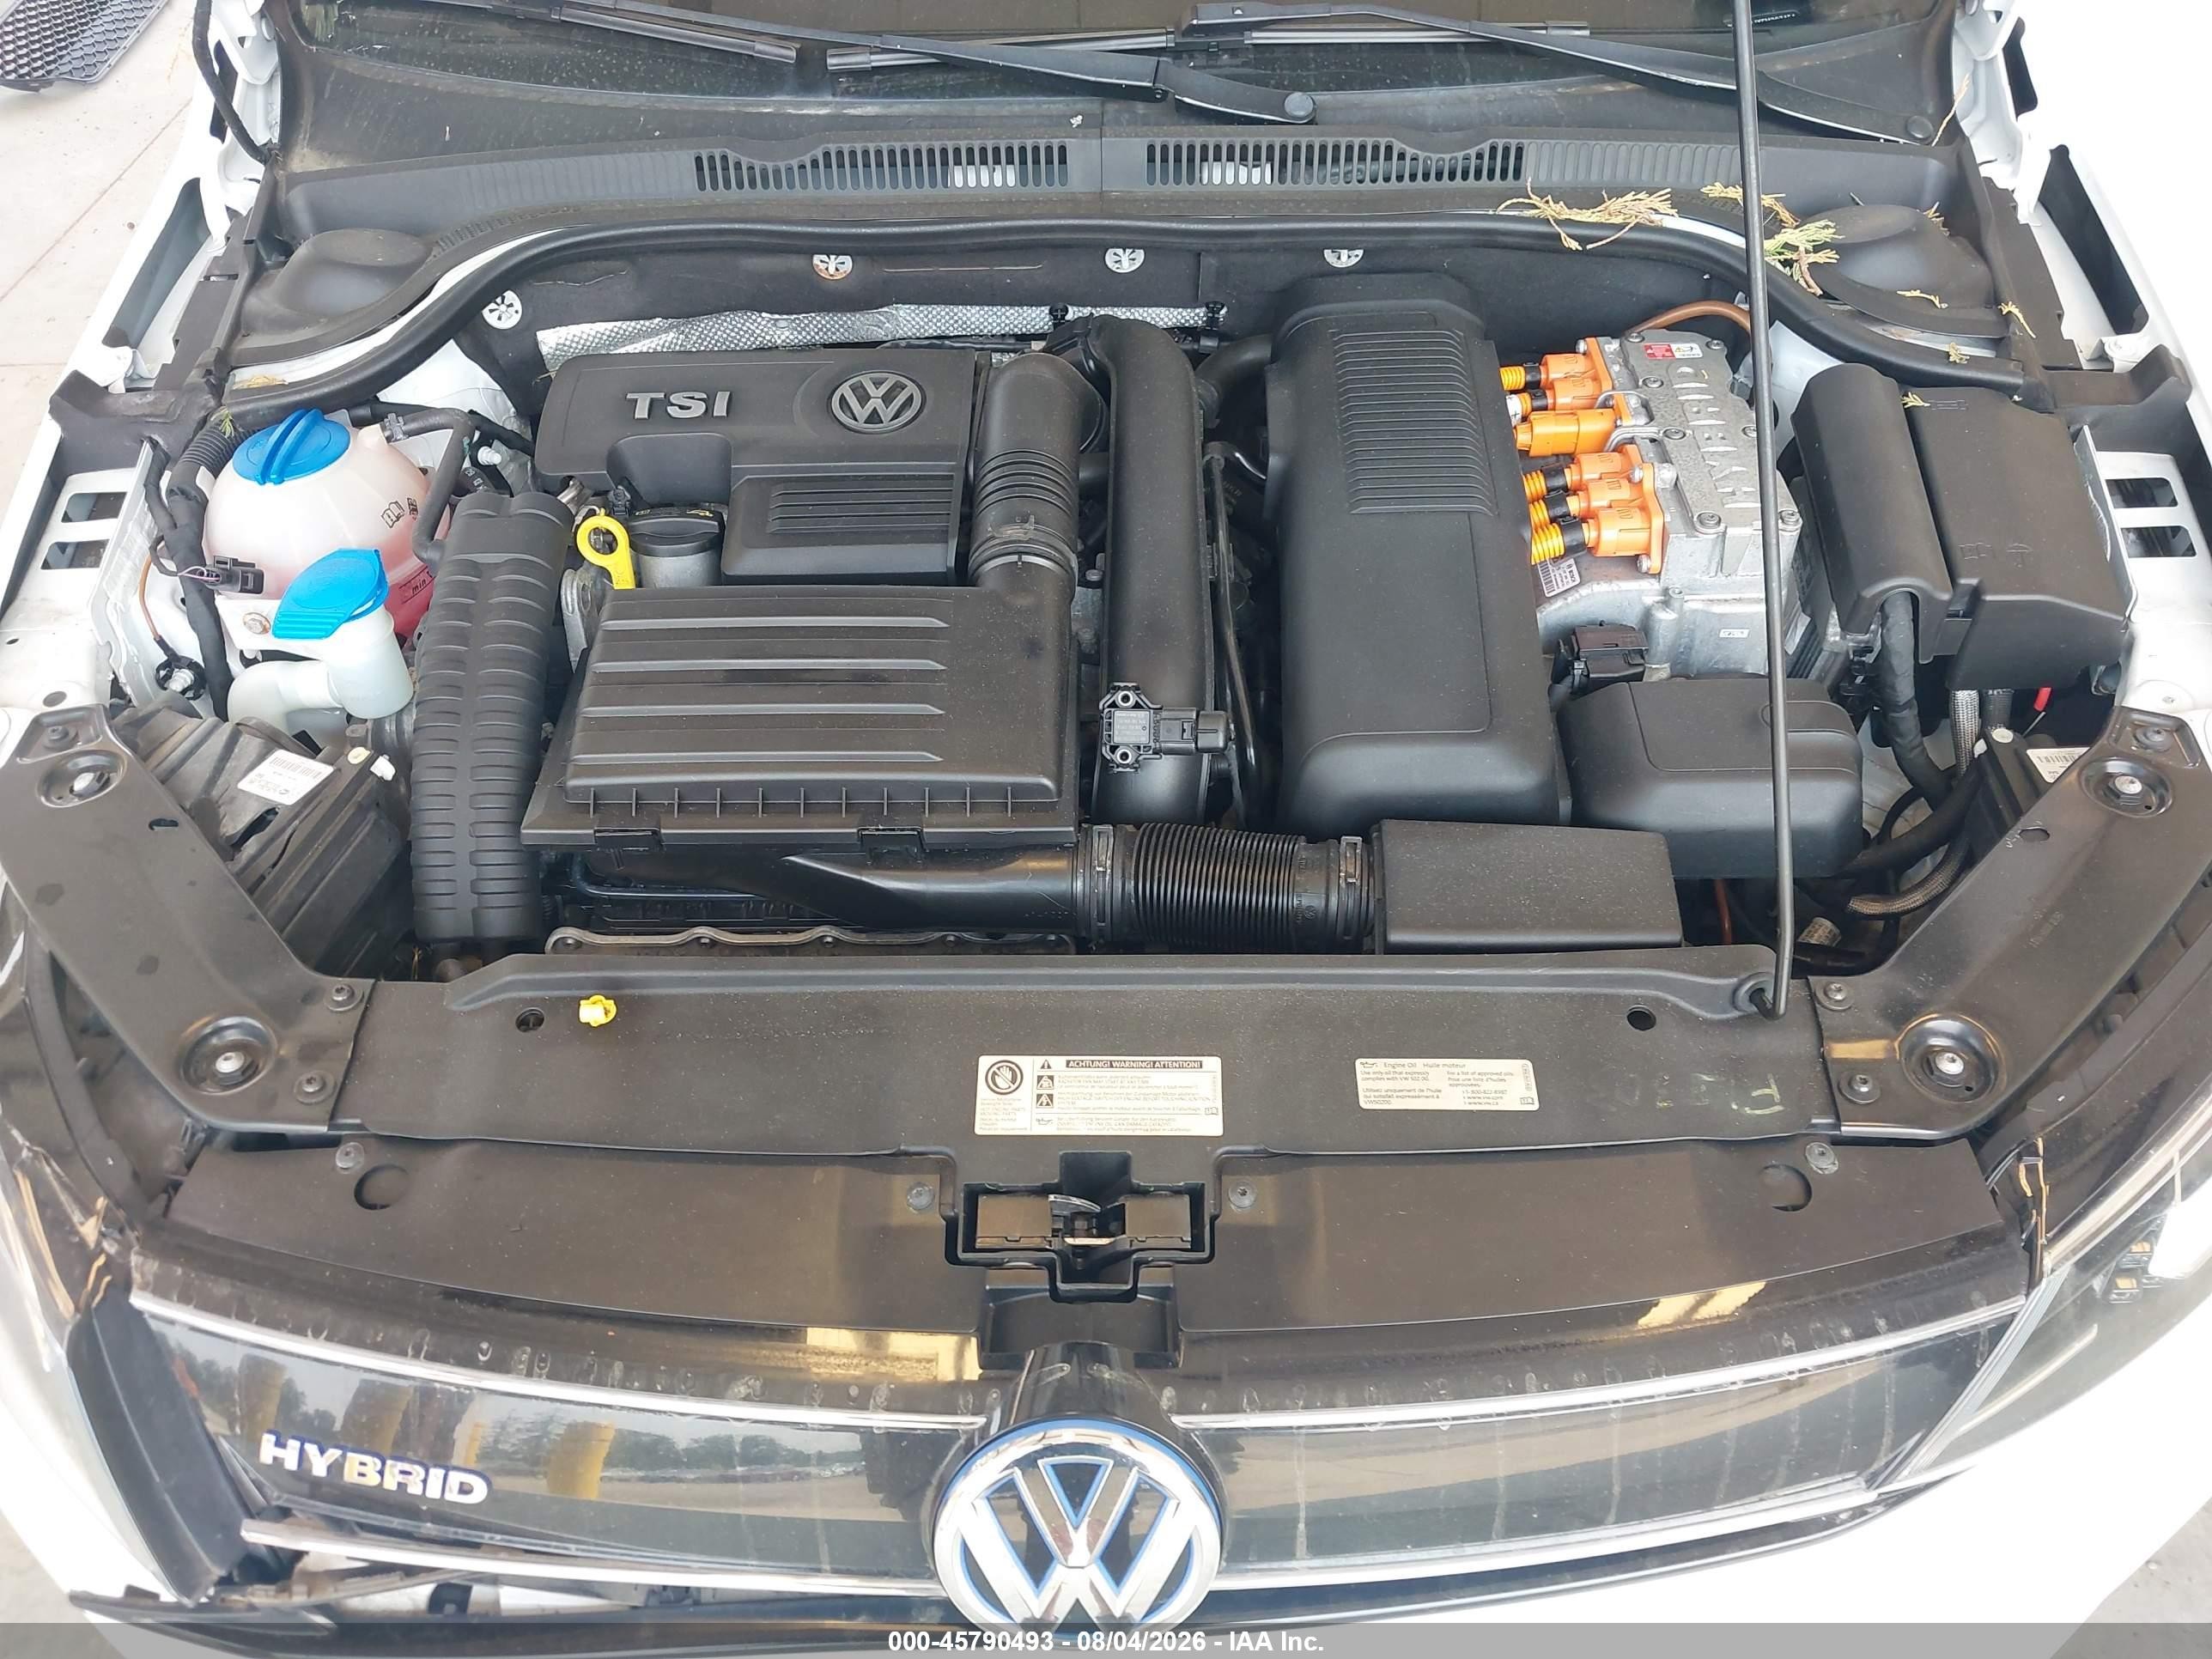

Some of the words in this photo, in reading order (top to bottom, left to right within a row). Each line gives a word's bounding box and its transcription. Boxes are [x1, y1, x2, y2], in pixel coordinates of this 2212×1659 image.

[626, 391, 730, 420] TSI
[412, 579, 426, 594] min
[259, 1431, 489, 1504] HYBRID
